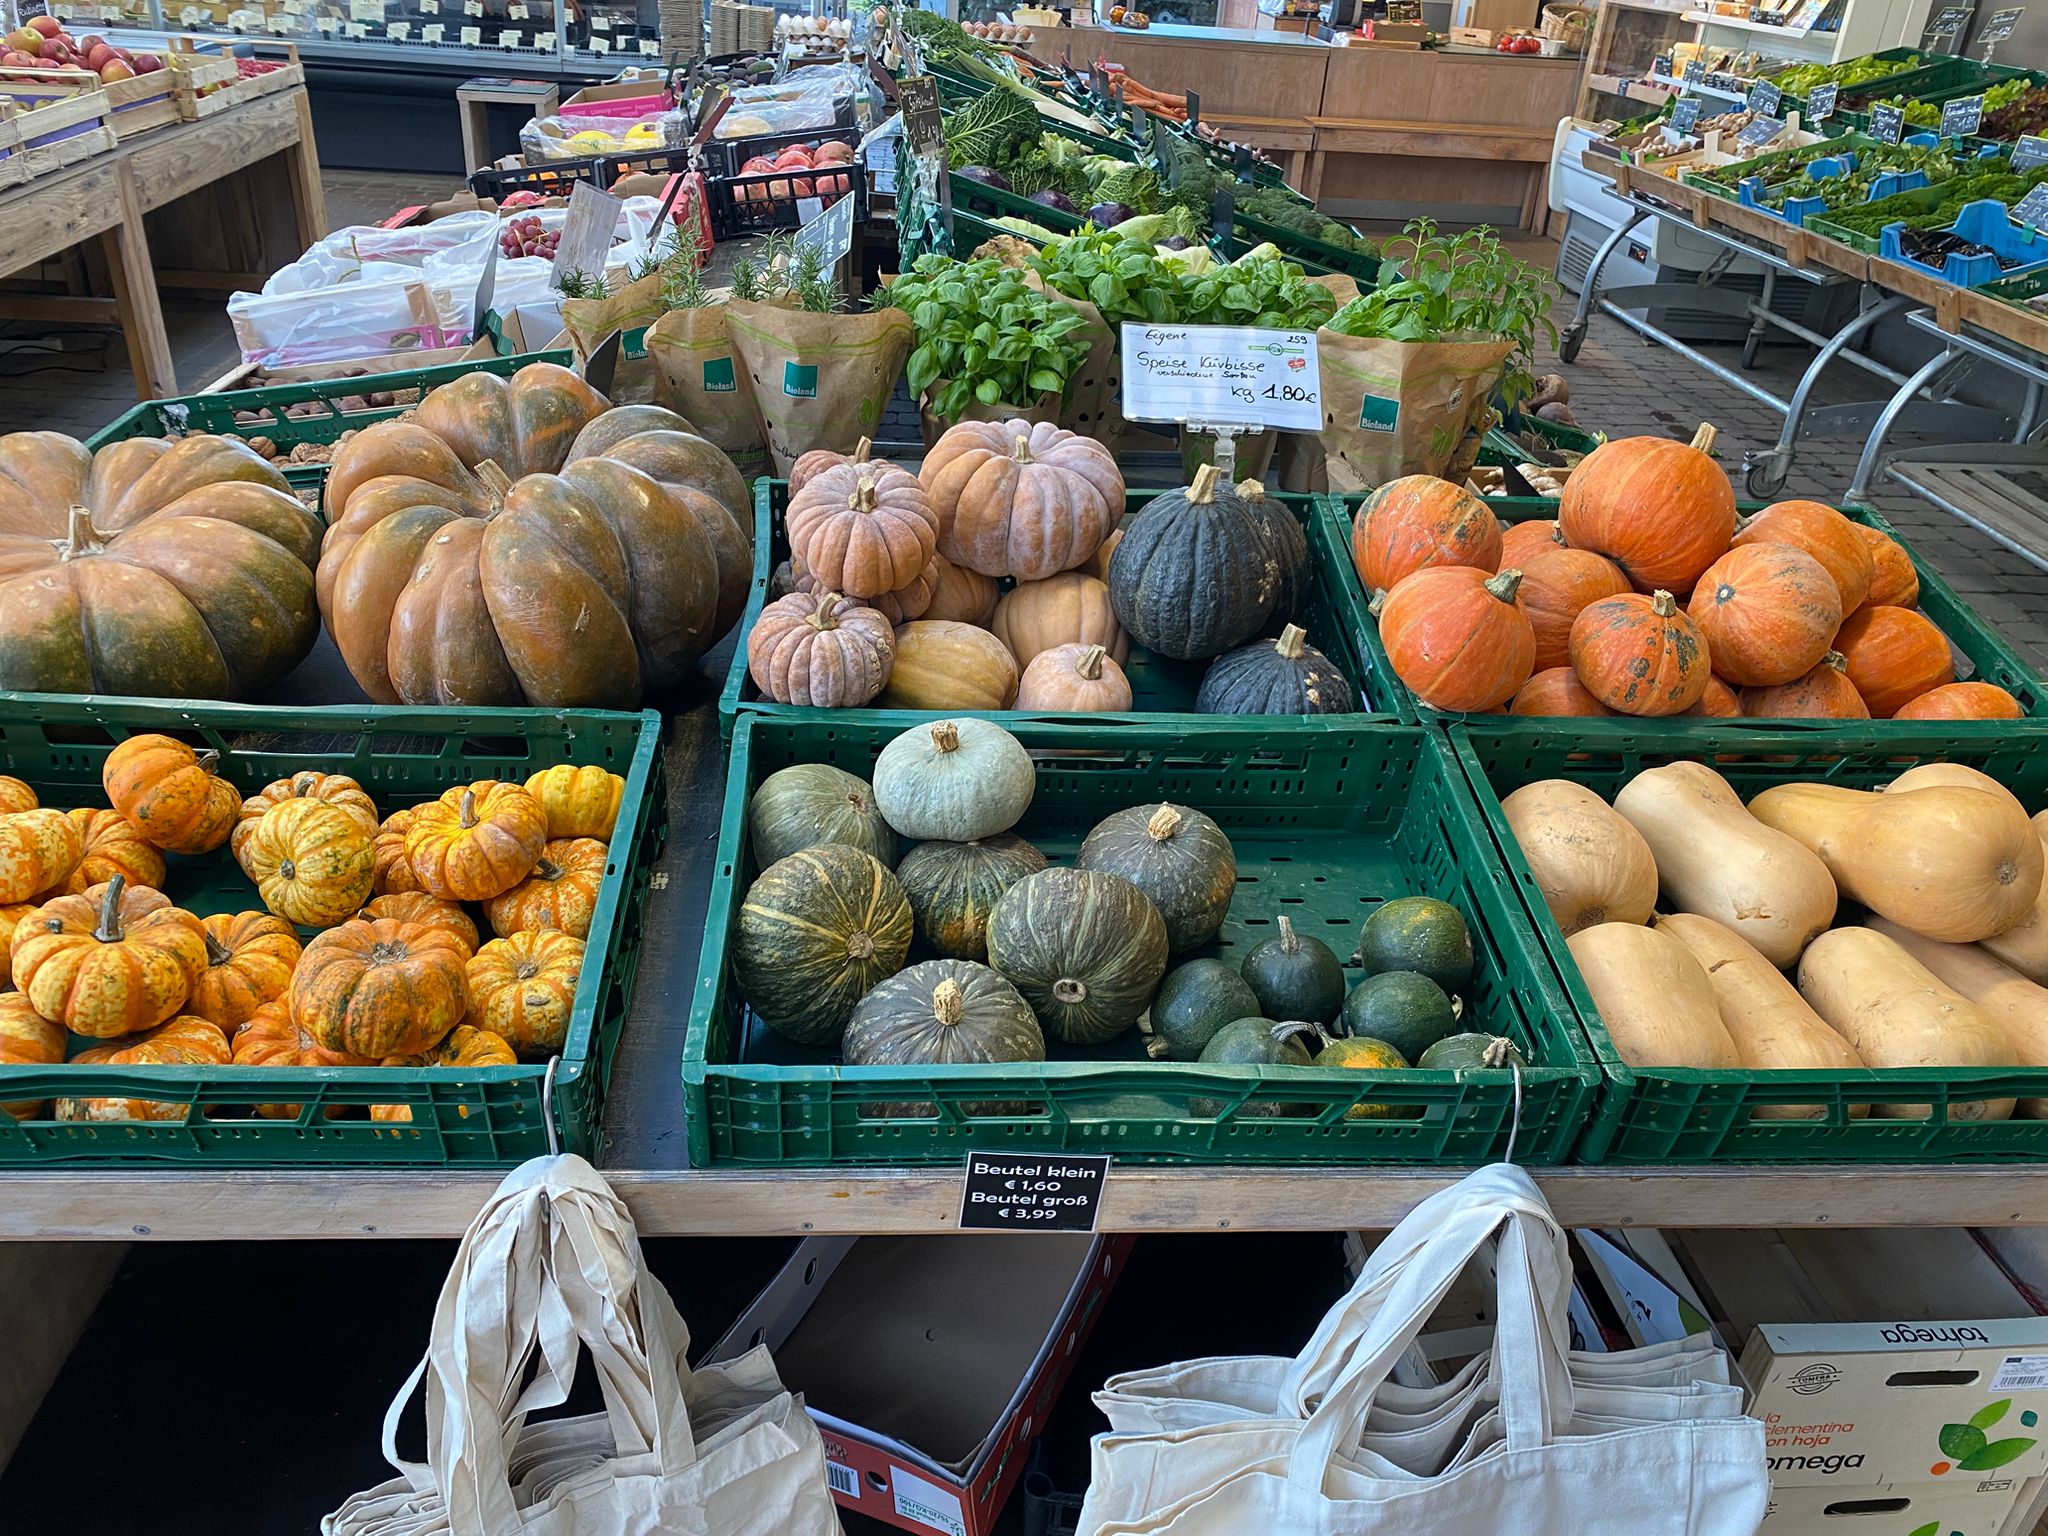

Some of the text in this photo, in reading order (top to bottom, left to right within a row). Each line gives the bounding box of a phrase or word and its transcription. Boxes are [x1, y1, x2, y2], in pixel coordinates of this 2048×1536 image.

[1145, 329, 1187, 345] Eigene
[1287, 335, 1308, 344] 259
[1137, 351, 1266, 373] Speise Kürbisse
[706, 380, 734, 390] Bioland
[785, 384, 815, 396] Bioland
[1361, 417, 1394, 431] Bioland
[974, 1162, 1097, 1178] Beutel klein
[1004, 1180, 1061, 1192] € 1,60
[971, 1192, 1089, 1207] Beutel groß
[998, 1208, 1057, 1220] € 3,99
[1880, 1324, 1989, 1343] tomega
[1765, 1413, 1782, 1424] la
[1765, 1422, 1855, 1435] clementina
[1766, 1434, 1831, 1448] on hoja
[1766, 1454, 1866, 1475] omega
